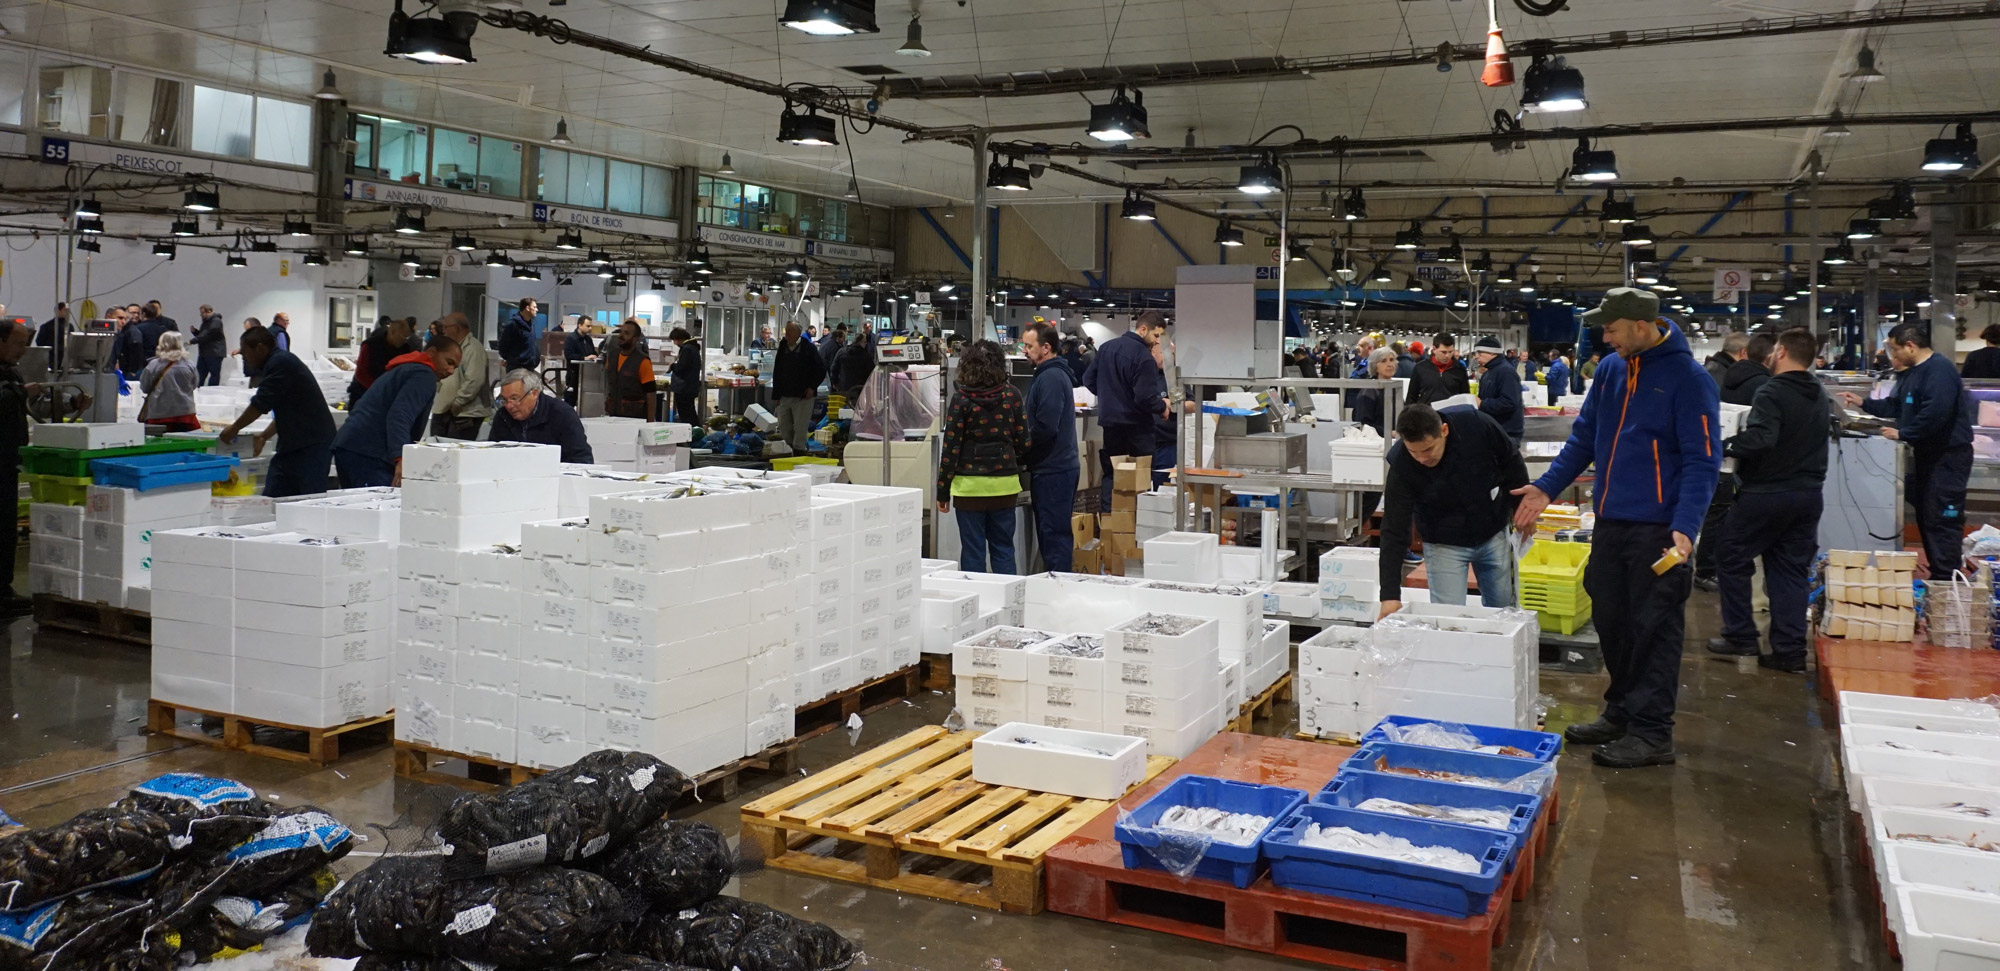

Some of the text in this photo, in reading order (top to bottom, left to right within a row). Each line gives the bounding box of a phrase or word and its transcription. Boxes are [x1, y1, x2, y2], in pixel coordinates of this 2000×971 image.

[45, 144, 66, 159] 55
[116, 154, 183, 173] PEIXESCOT
[431, 195, 448, 207] 2001
[535, 208, 546, 218] 53
[592, 215, 600, 226] DE
[719, 232, 765, 247] CONSIGNACIONES
[1303, 650, 1313, 666] 3
[1303, 679, 1313, 696] 3
